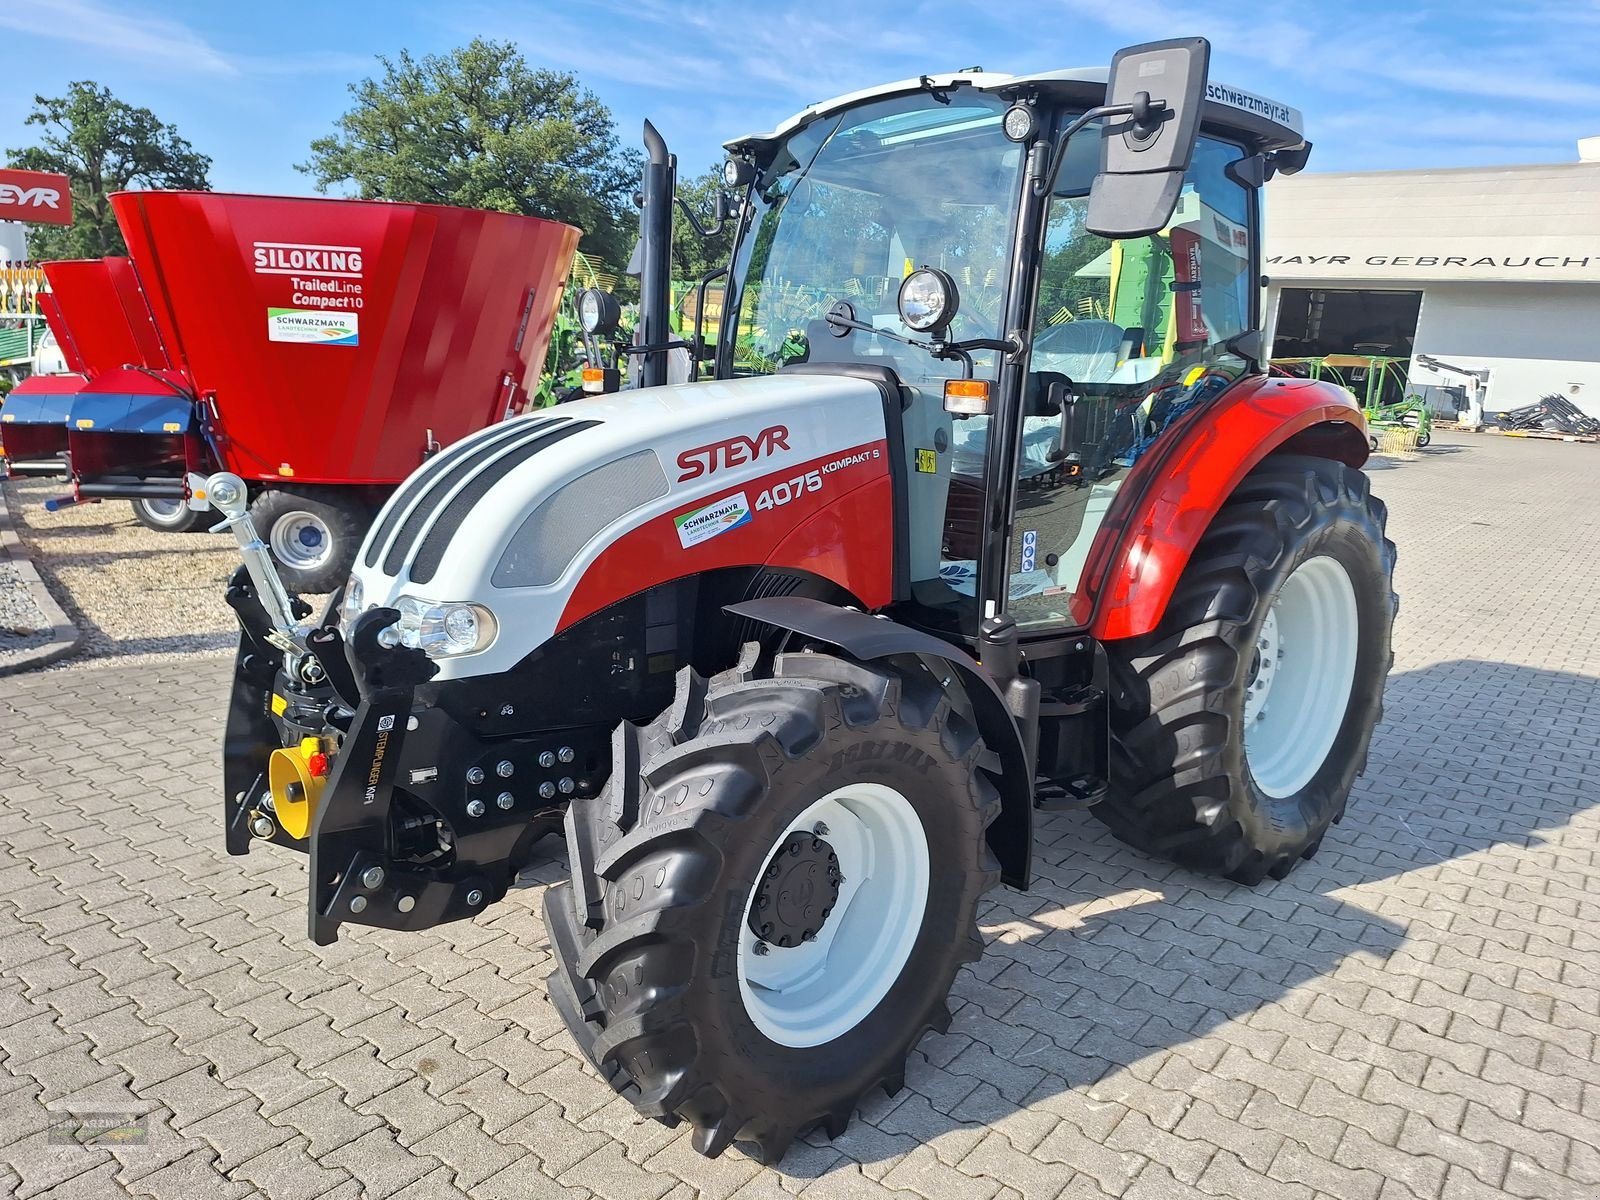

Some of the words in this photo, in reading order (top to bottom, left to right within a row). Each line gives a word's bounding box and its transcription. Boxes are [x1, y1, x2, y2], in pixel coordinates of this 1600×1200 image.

[254, 248, 362, 272] SILOKING
[1365, 256, 1600, 267] GEBRAUCH
[291, 277, 362, 294] TrailedLine
[276, 316, 346, 328] SCHWARZMAYR
[676, 424, 791, 483] STEYR
[754, 470, 823, 512] 4075
[821, 450, 872, 475] KOMPAKT
[872, 449, 880, 459] S
[683, 503, 739, 530] SCHWARZMAYR
[368, 731, 389, 786] STEMPLINGER
